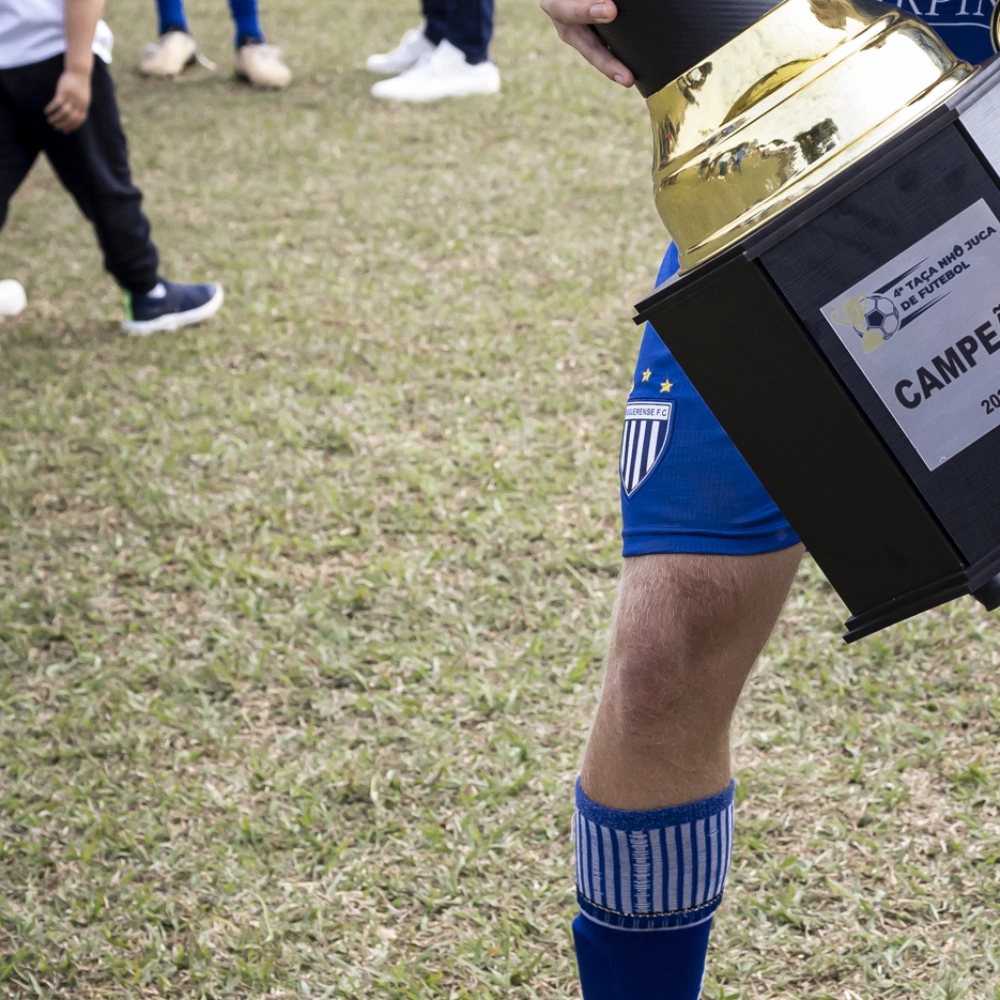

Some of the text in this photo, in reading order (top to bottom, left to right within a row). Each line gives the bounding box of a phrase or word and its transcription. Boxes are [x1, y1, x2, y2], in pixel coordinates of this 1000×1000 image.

[900, 261, 971, 311] DE FUTEBOL
[905, 266, 938, 290] TAÇA
[937, 244, 964, 269] NHÔ
[964, 226, 997, 251] JUCA
